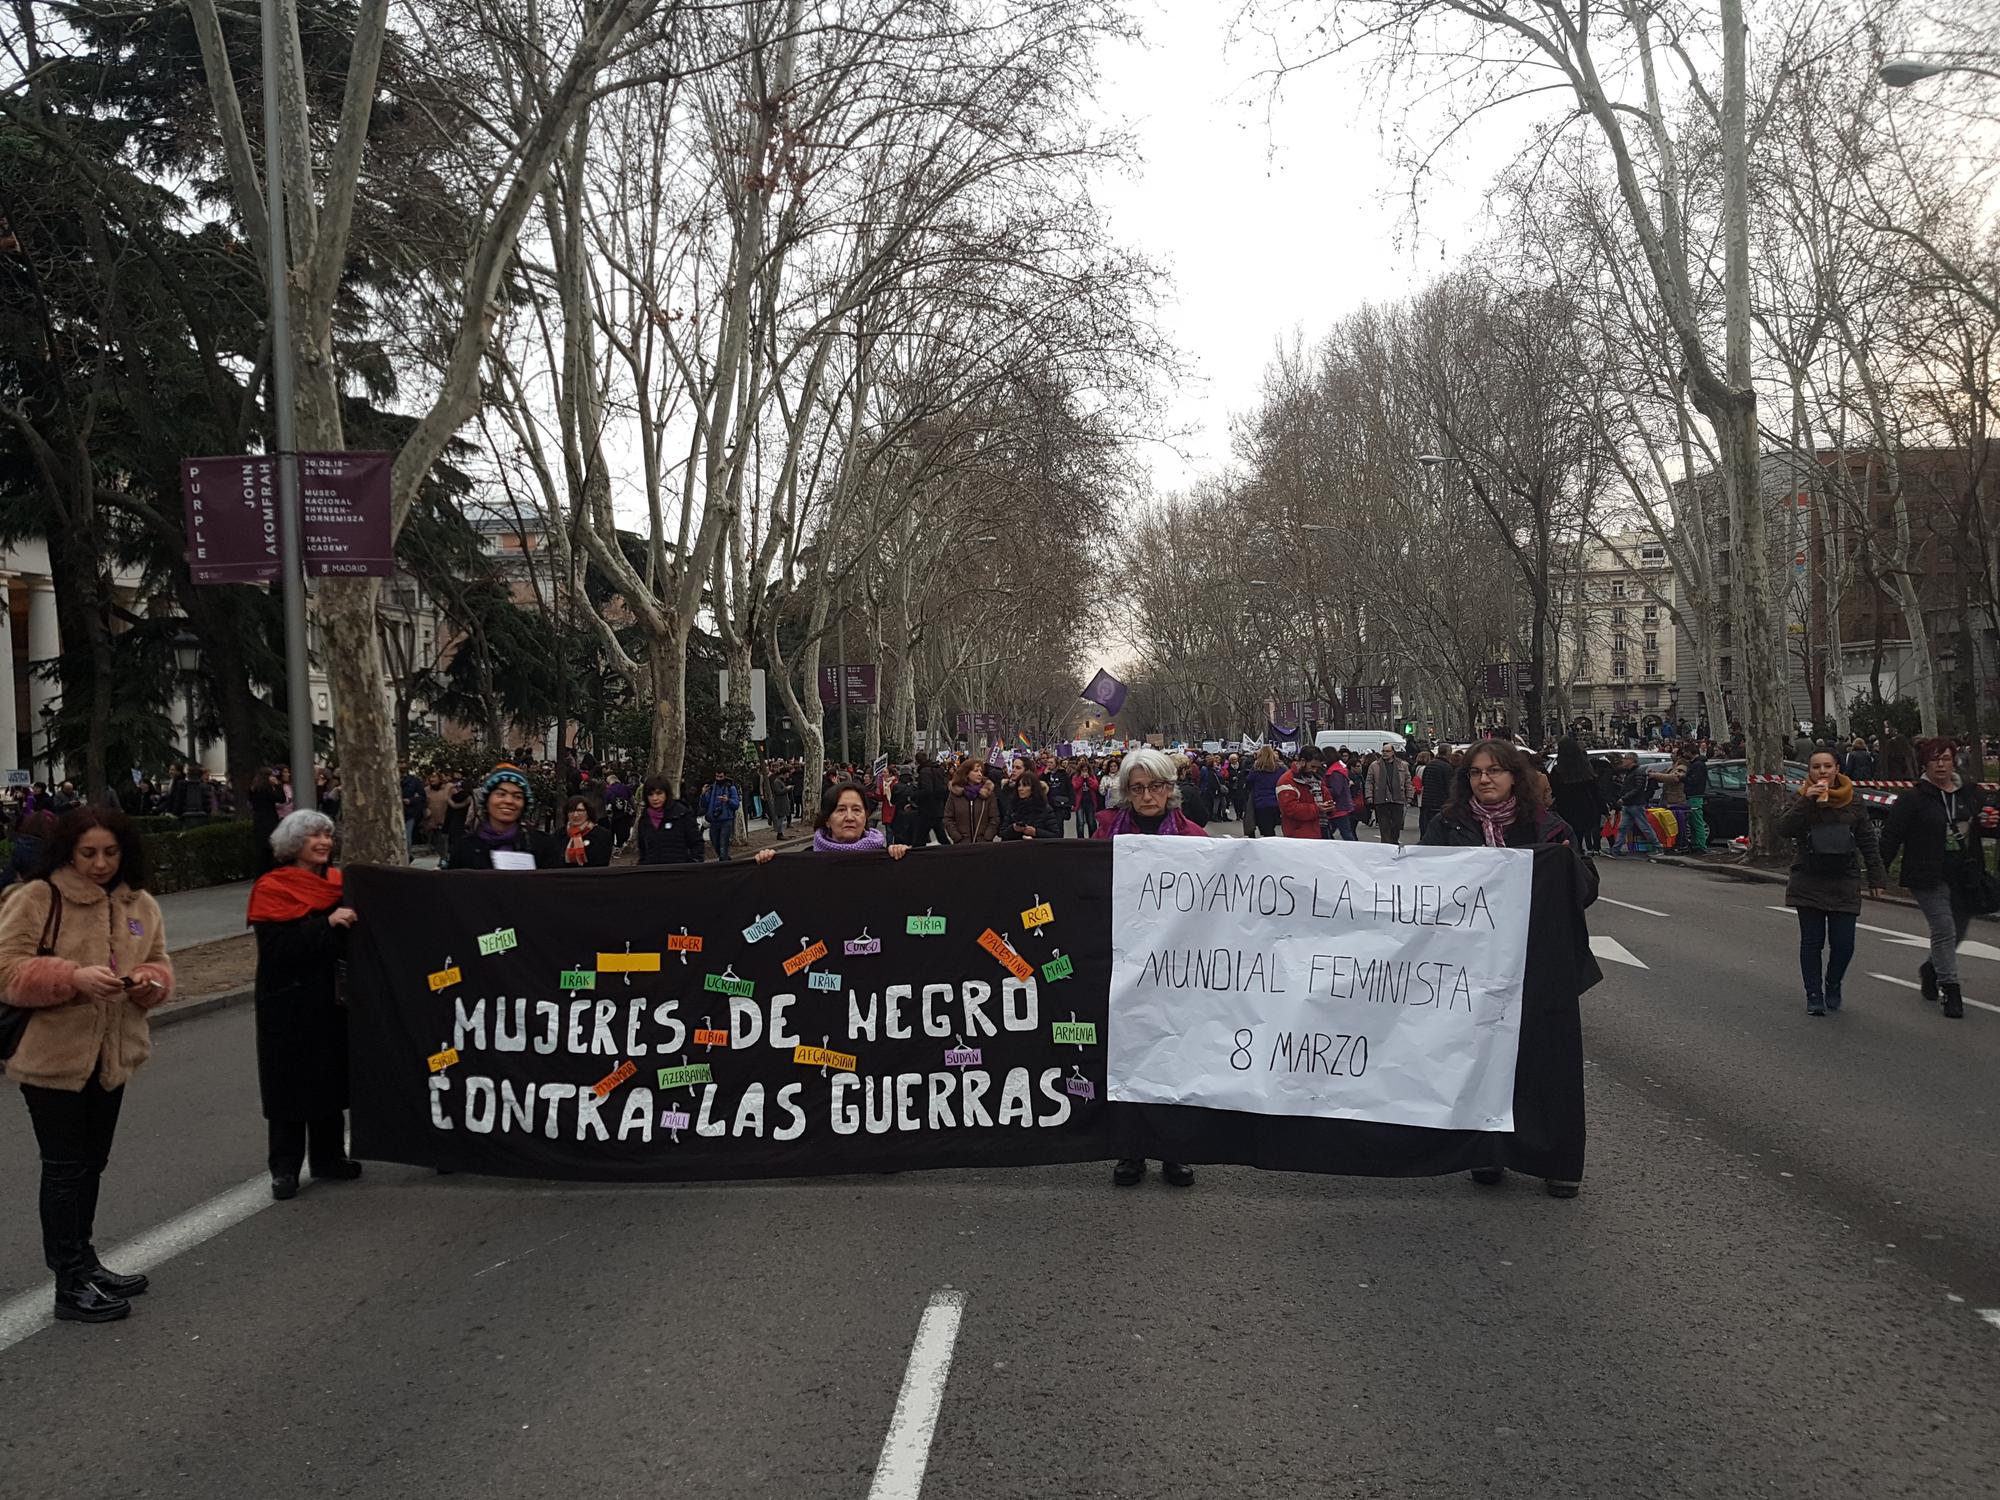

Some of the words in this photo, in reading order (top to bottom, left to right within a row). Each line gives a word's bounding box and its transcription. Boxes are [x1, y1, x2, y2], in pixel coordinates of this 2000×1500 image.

[242, 465, 255, 508] JOHN
[190, 467, 206, 558] PURPLE
[259, 464, 277, 555] AKOMFRAH
[332, 564, 367, 572] MADRID
[1137, 872, 1295, 917] APOYAMOS
[1312, 878, 1354, 920] LA
[1374, 882, 1495, 930] HUELGA
[912, 919, 942, 931] SIRIA
[1028, 910, 1049, 925] RCA
[482, 931, 514, 952] YEMEN
[670, 938, 700, 949] NIGER
[784, 945, 825, 972] PAQUISTAN
[983, 932, 1028, 977] PALESTINA
[1046, 958, 1070, 976] MALI
[563, 974, 590, 986] IRAK
[1137, 948, 1285, 993] MUNDIAL
[1309, 954, 1472, 1012] FEMINISTA
[454, 997, 685, 1056] MUJERES
[729, 994, 799, 1049] DE
[849, 976, 1038, 1041] NEGRO
[697, 1031, 724, 1042] LIBIA
[1055, 1026, 1094, 1042] ARMENIA
[797, 1049, 854, 1068] AFGANISTAN
[947, 1053, 979, 1064] SUDAN
[1230, 1028, 1252, 1070] 8
[1269, 1031, 1368, 1077] MARZO
[1068, 1081, 1091, 1093] CHAD
[428, 1075, 654, 1142] CONTRA
[696, 1083, 806, 1140] LAS
[831, 1067, 1070, 1134] GUERRAS
